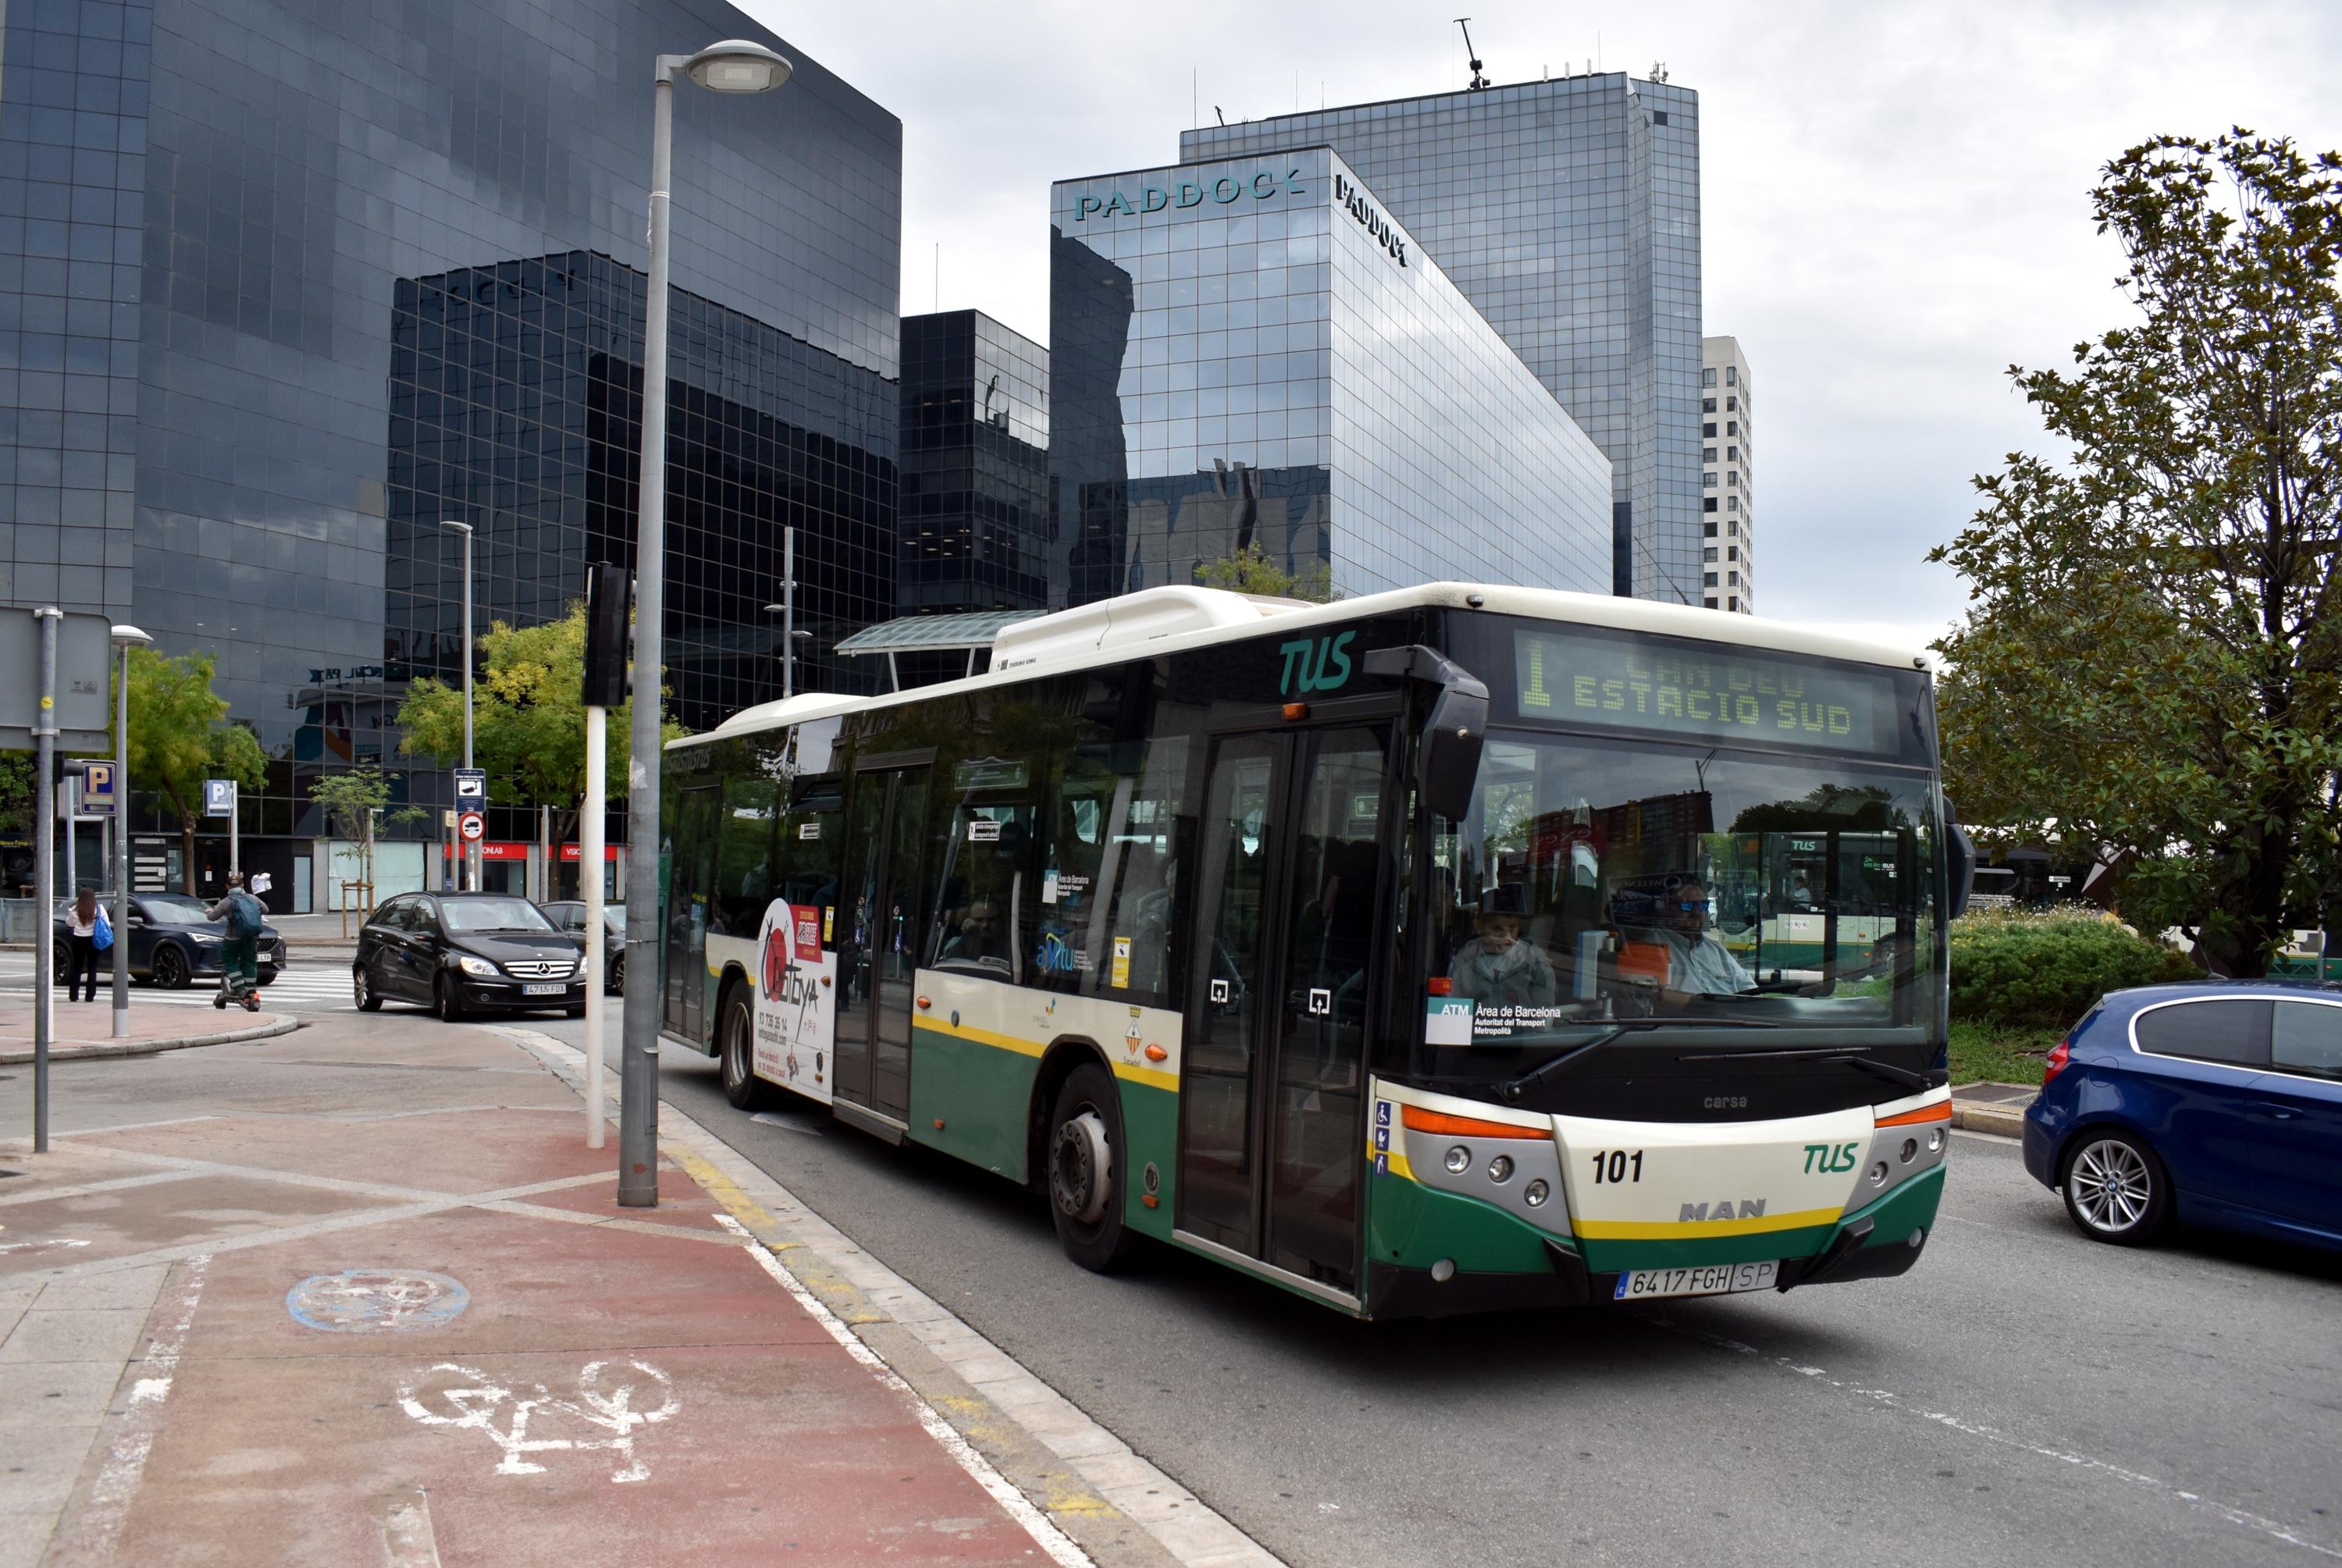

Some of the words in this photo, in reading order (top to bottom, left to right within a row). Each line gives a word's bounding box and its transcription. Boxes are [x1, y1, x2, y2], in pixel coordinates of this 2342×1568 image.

[1074, 169, 1305, 222] PADDOCK
[1335, 174, 1408, 268] PADDOCK
[1280, 630, 1357, 695] TUS
[1523, 637, 1551, 706] 1
[1574, 674, 1759, 725] ESTACIO
[1777, 699, 1850, 734] SUD
[89, 766, 109, 793] P
[212, 783, 226, 802] P
[1792, 841, 1816, 851] TUS
[1441, 1004, 1469, 1015] ATM
[1475, 1002, 1498, 1017] Àrea
[1500, 1005, 1512, 1017] de
[1514, 1005, 1561, 1018] Barcelona
[1474, 1018, 1504, 1026] Autoritat
[1504, 1018, 1514, 1026] del
[1515, 1018, 1546, 1028] Transport
[1474, 1026, 1511, 1036] Metropolità
[1703, 1096, 1748, 1109] carsa
[1592, 1149, 1643, 1184] 101
[1803, 1142, 1859, 1175] TUS
[1678, 1198, 1767, 1222] MAN
[1633, 1270, 1686, 1294] 6417
[1689, 1266, 1729, 1291] FGH
[1739, 1263, 1773, 1287] SP
